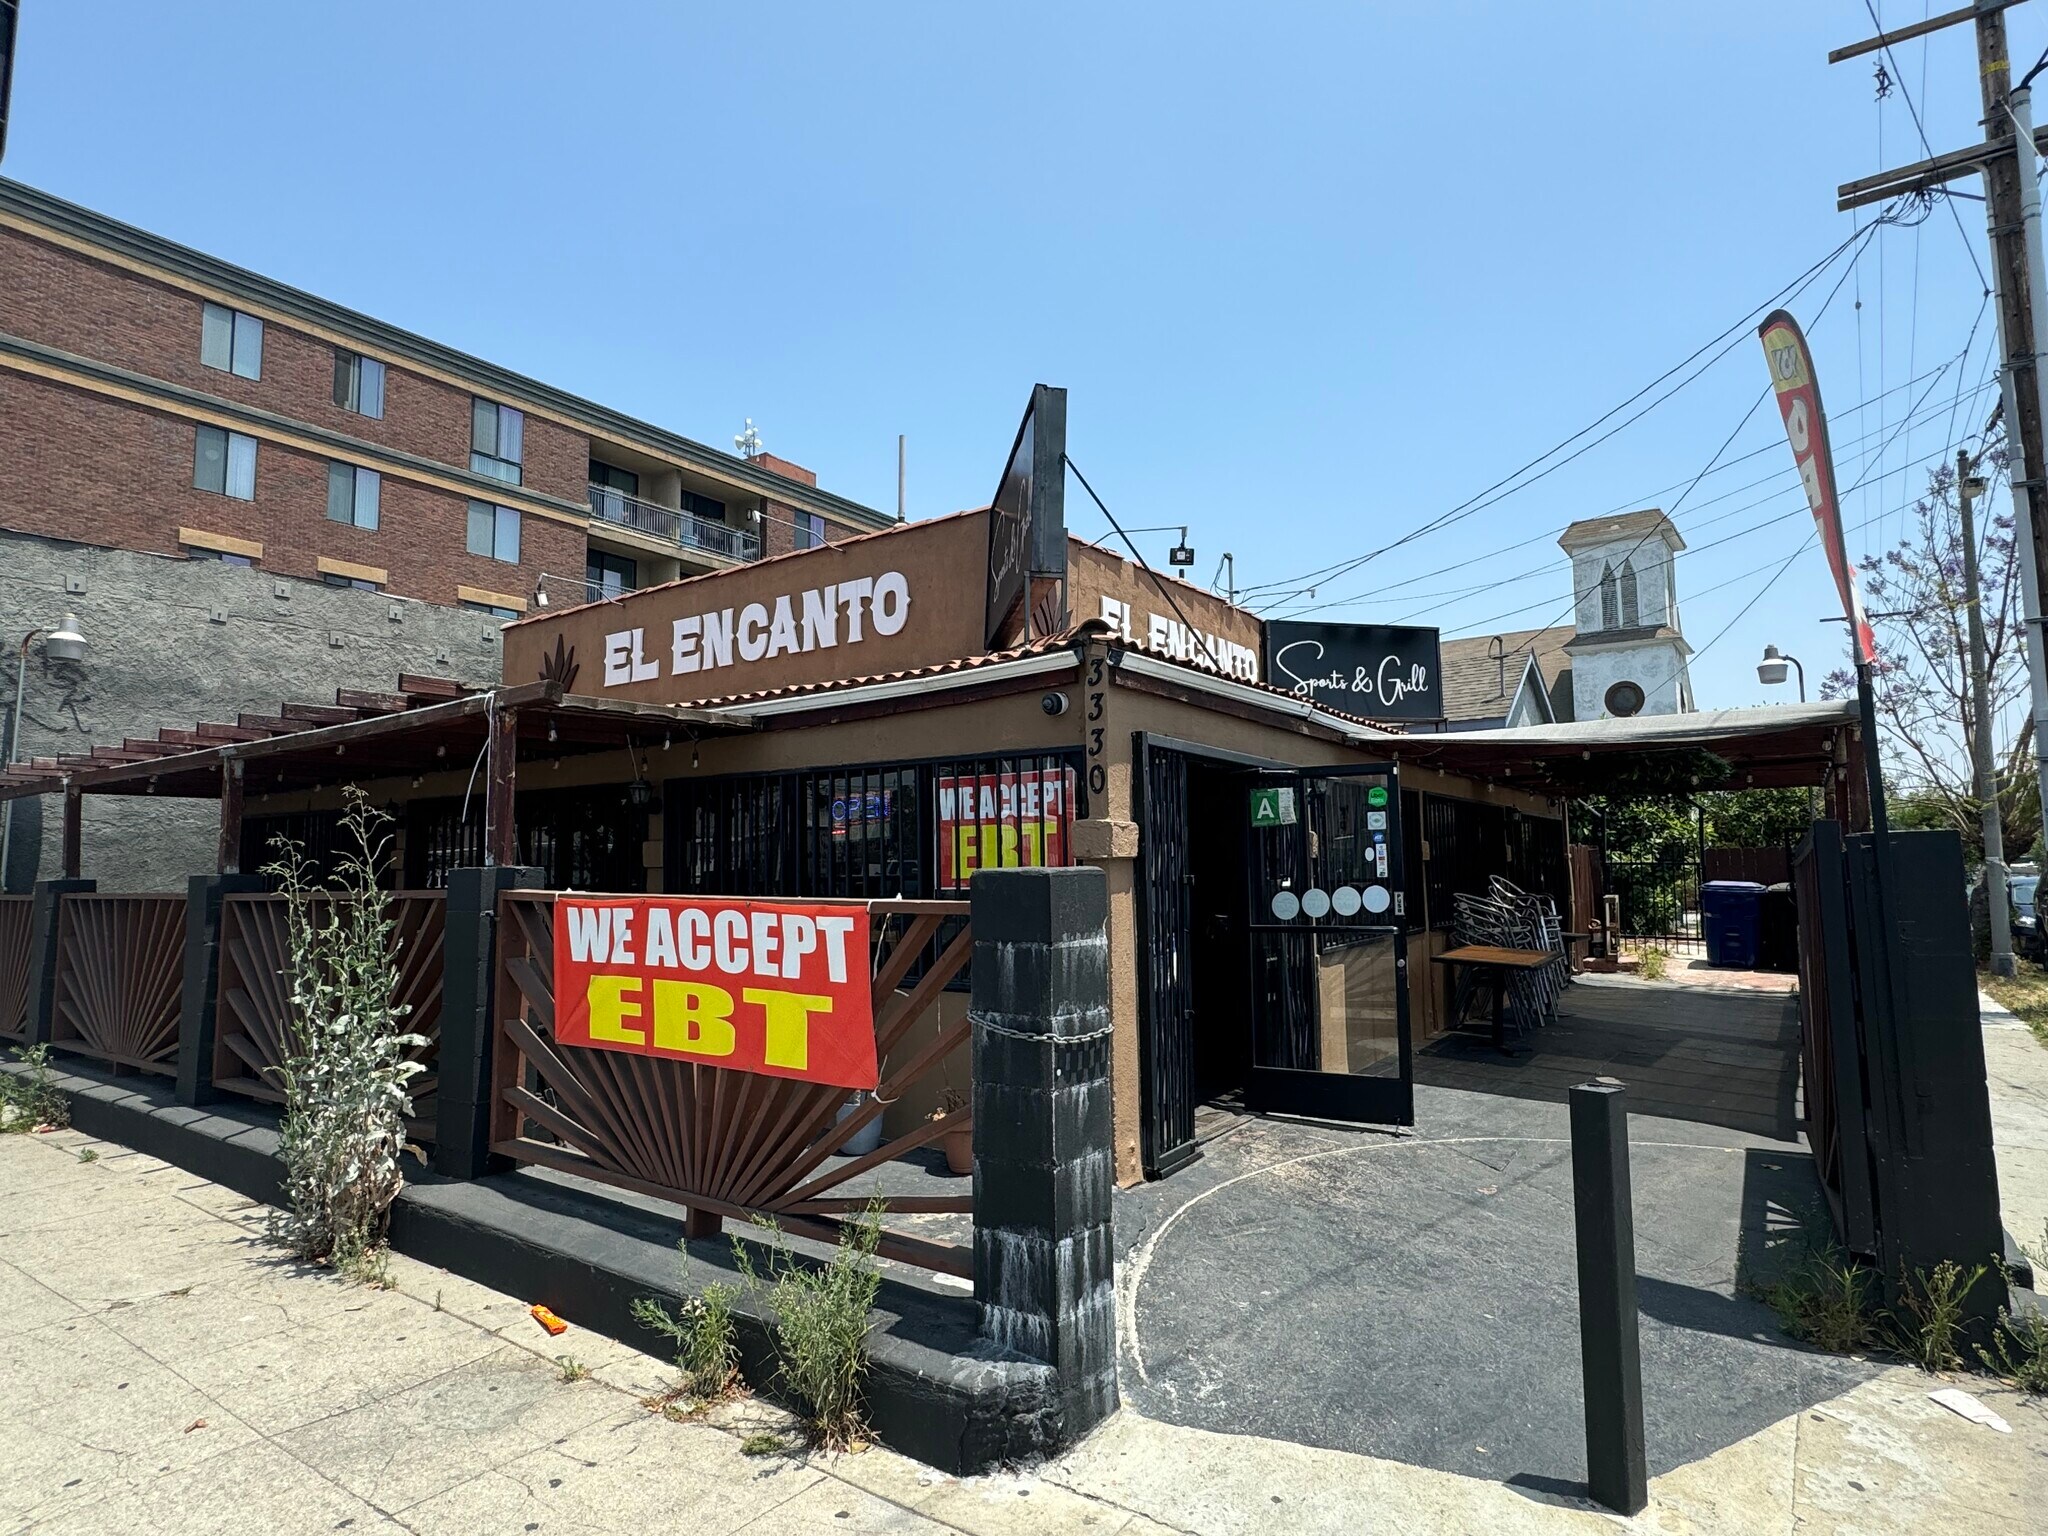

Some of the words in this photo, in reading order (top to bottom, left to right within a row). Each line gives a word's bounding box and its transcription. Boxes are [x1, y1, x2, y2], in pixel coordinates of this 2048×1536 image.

[603, 627, 660, 687] EL
[672, 571, 912, 676] ENCANTO
[1100, 595, 1141, 645] EL
[1148, 612, 1259, 685] ENCANTO
[1276, 640, 1349, 697] Sports
[1351, 666, 1373, 693] &
[1377, 655, 1429, 706] Grill
[1087, 658, 1106, 795] 3330
[939, 786, 975, 821] WE
[980, 780, 1069, 819] ACCEPT
[1256, 797, 1275, 819] A
[951, 821, 1057, 880] EBT
[566, 906, 635, 965] WE
[645, 907, 854, 984] ACCEPT
[587, 974, 834, 1071] EBT
